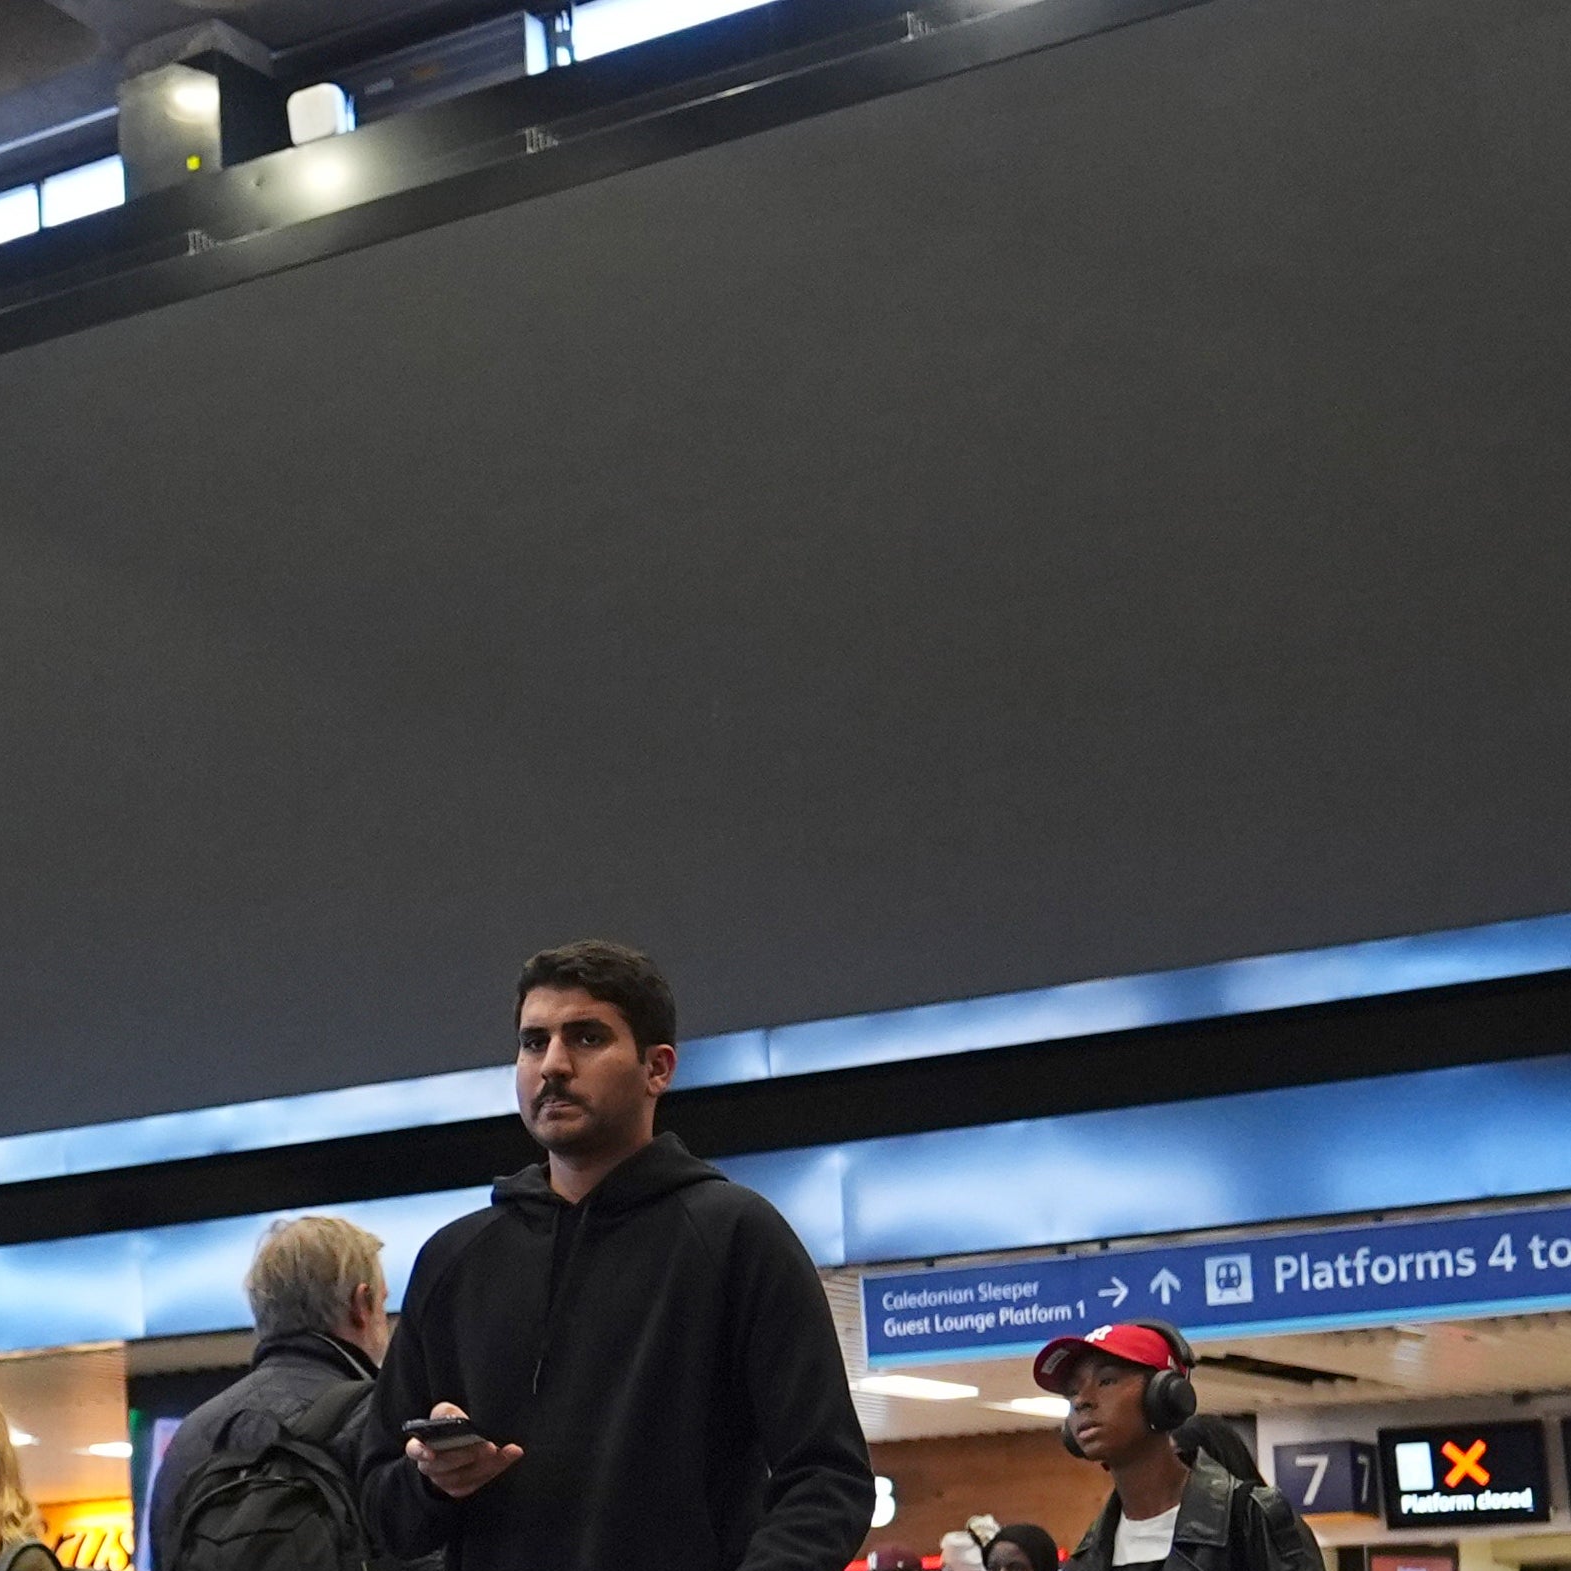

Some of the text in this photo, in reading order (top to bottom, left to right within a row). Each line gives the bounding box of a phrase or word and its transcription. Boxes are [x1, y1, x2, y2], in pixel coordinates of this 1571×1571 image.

[1274, 1232, 1571, 1293] Platforms 4 to
[882, 1280, 1040, 1311] Caledonian Sleeper
[884, 1299, 1085, 1338] Guest Lounge Platform 1
[1295, 1454, 1329, 1506] 7
[1400, 1486, 1533, 1515] Platform closed
